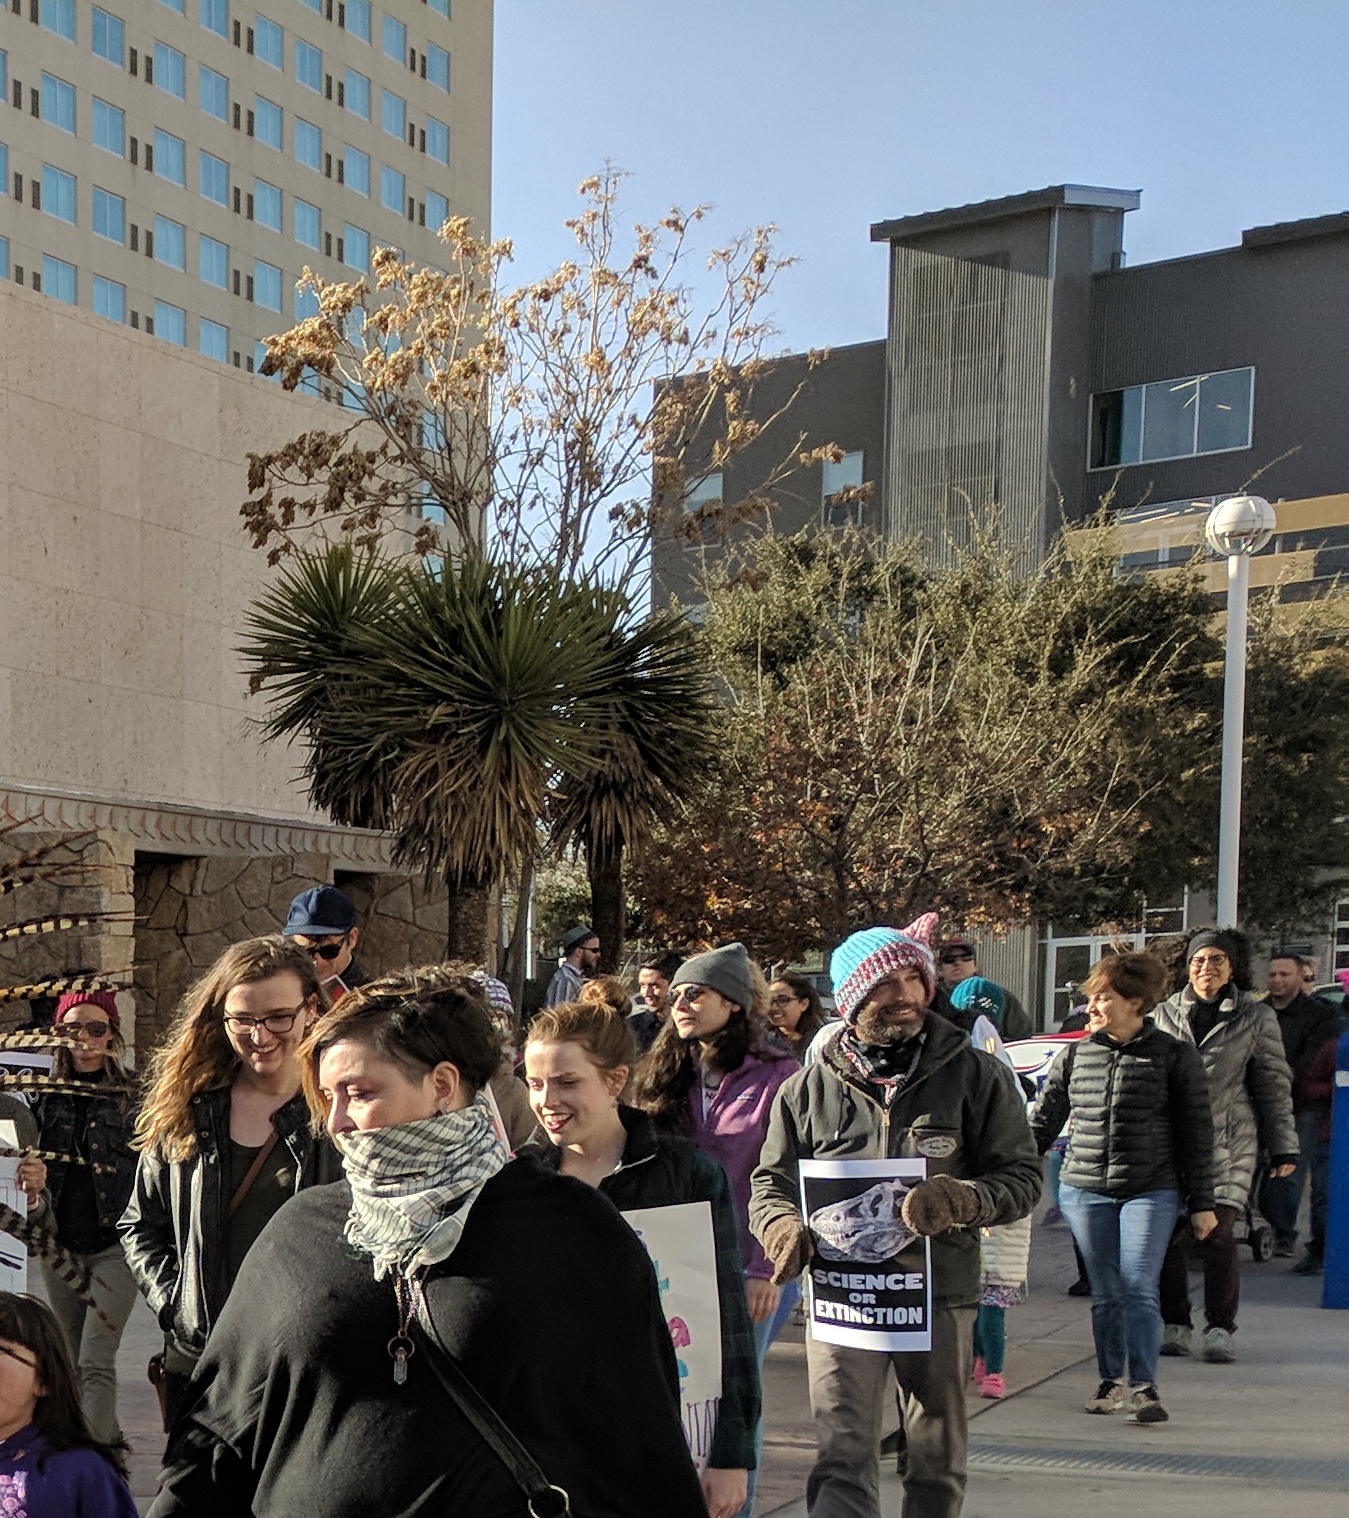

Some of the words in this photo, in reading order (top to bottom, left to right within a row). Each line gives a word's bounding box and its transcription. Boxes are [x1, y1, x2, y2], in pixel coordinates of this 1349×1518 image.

[812, 1268, 924, 1291] SCIENCE
[848, 1292, 877, 1305] OR
[814, 1298, 923, 1325] EXTINCTION
